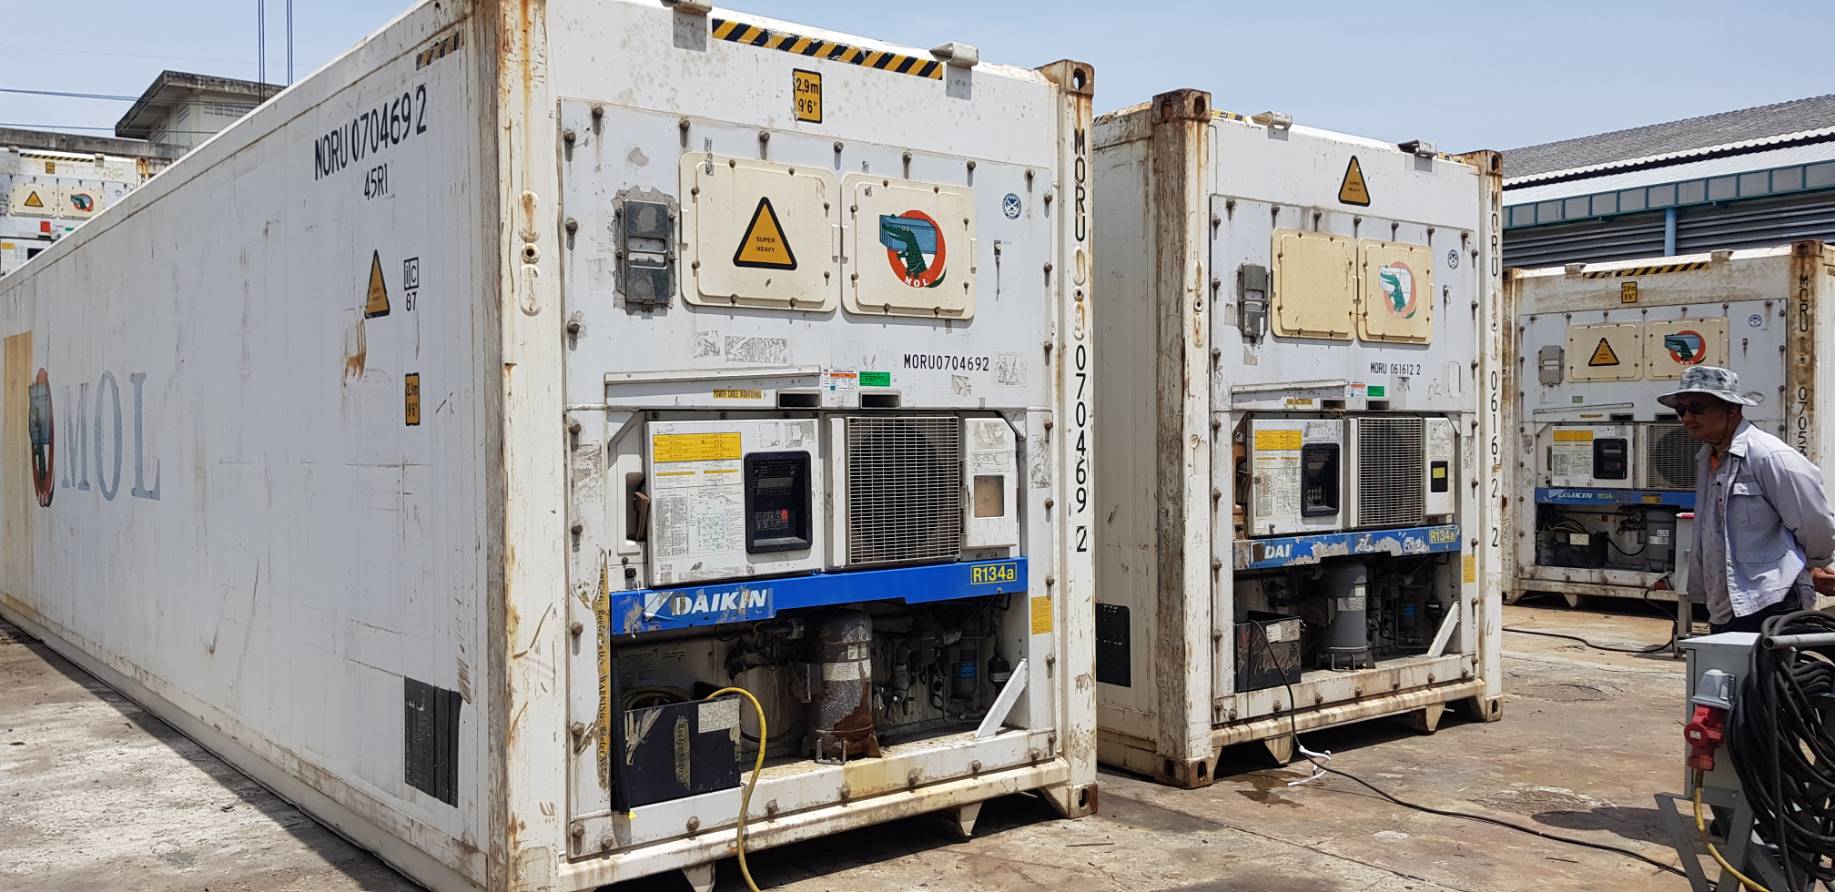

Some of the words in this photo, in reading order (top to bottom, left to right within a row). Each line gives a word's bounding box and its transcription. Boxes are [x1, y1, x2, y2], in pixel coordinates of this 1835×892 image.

[352, 91, 411, 163] 070469
[416, 82, 427, 135] 2
[1074, 128, 1086, 242] MORU
[904, 277, 929, 288] MOL
[406, 291, 417, 311] 87
[904, 353, 989, 372] MORU0704692
[1370, 362, 1387, 374] MORU
[61, 369, 160, 501] MOL
[1075, 344, 1086, 513] 070469
[1076, 525, 1087, 553] 2
[973, 565, 1014, 583] R134a
[672, 589, 768, 616] DAIKIN
